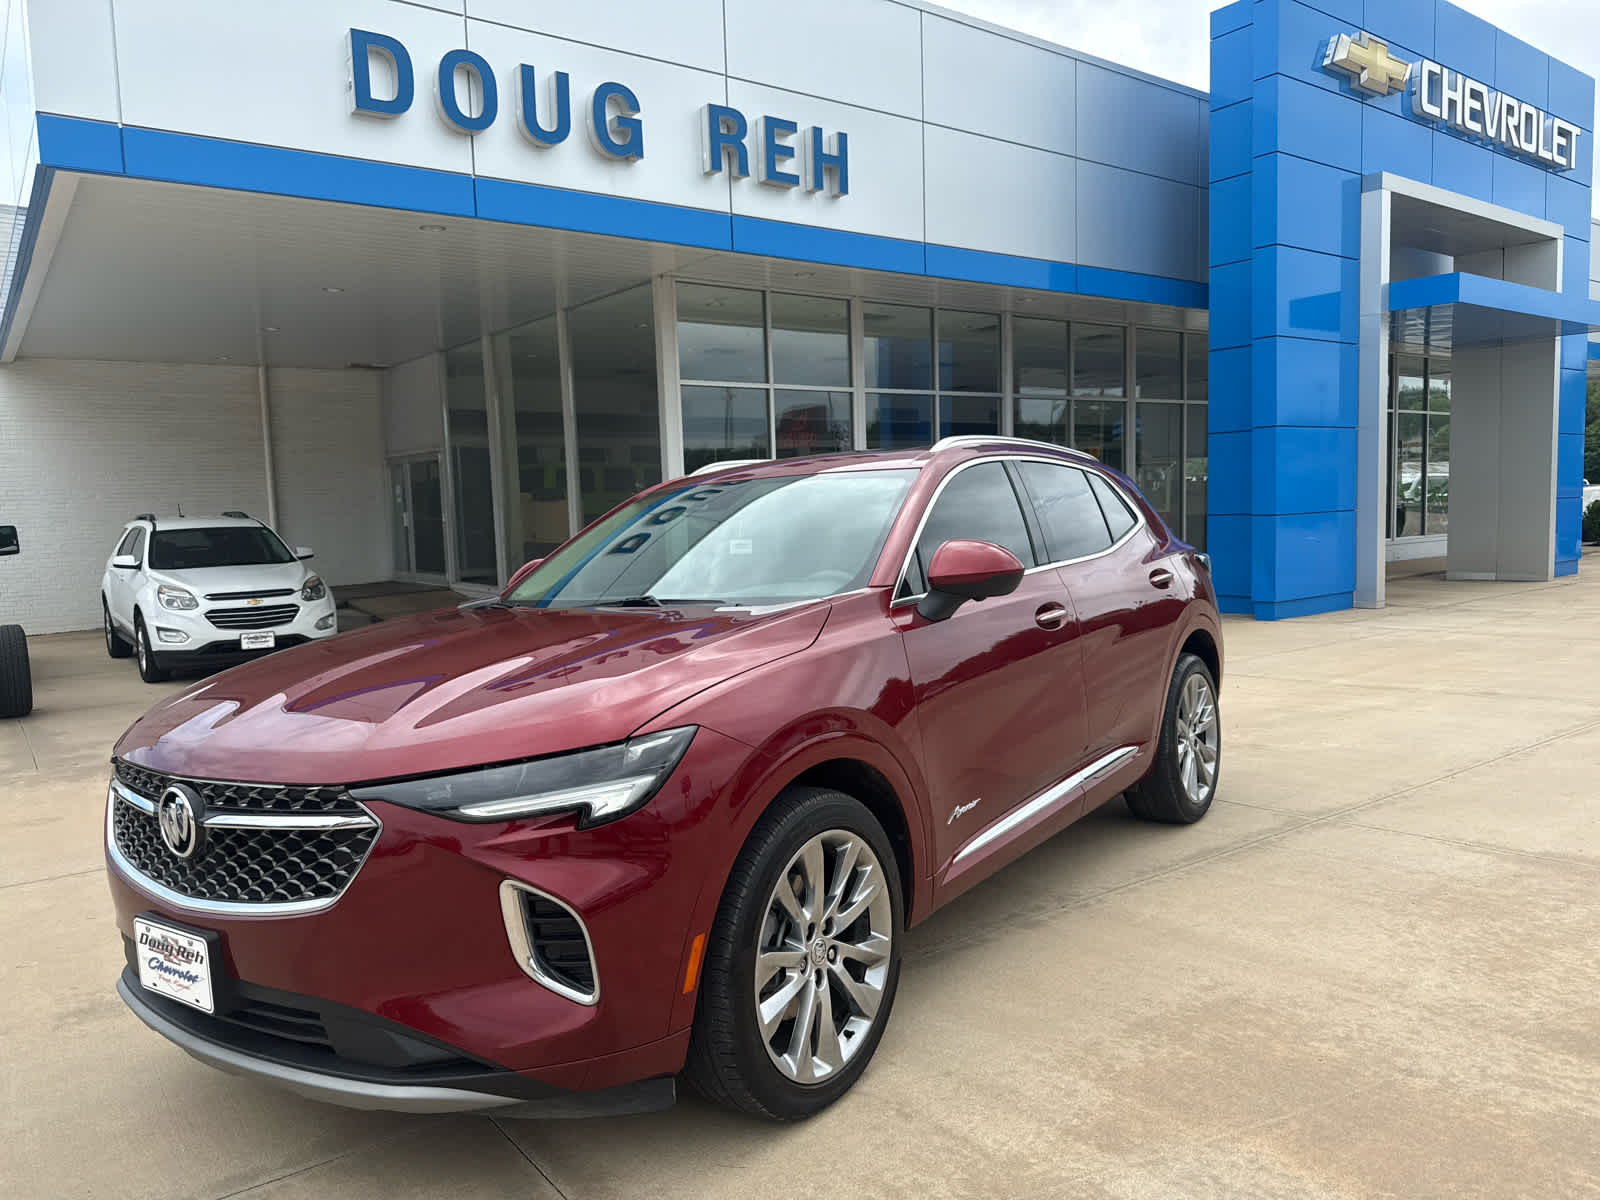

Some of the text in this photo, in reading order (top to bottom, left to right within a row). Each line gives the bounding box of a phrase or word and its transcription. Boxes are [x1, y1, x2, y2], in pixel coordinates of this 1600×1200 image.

[347, 28, 849, 199] DOUG REH
[1420, 59, 1581, 170] CHEVROLET
[176, 945, 204, 965] Reh
